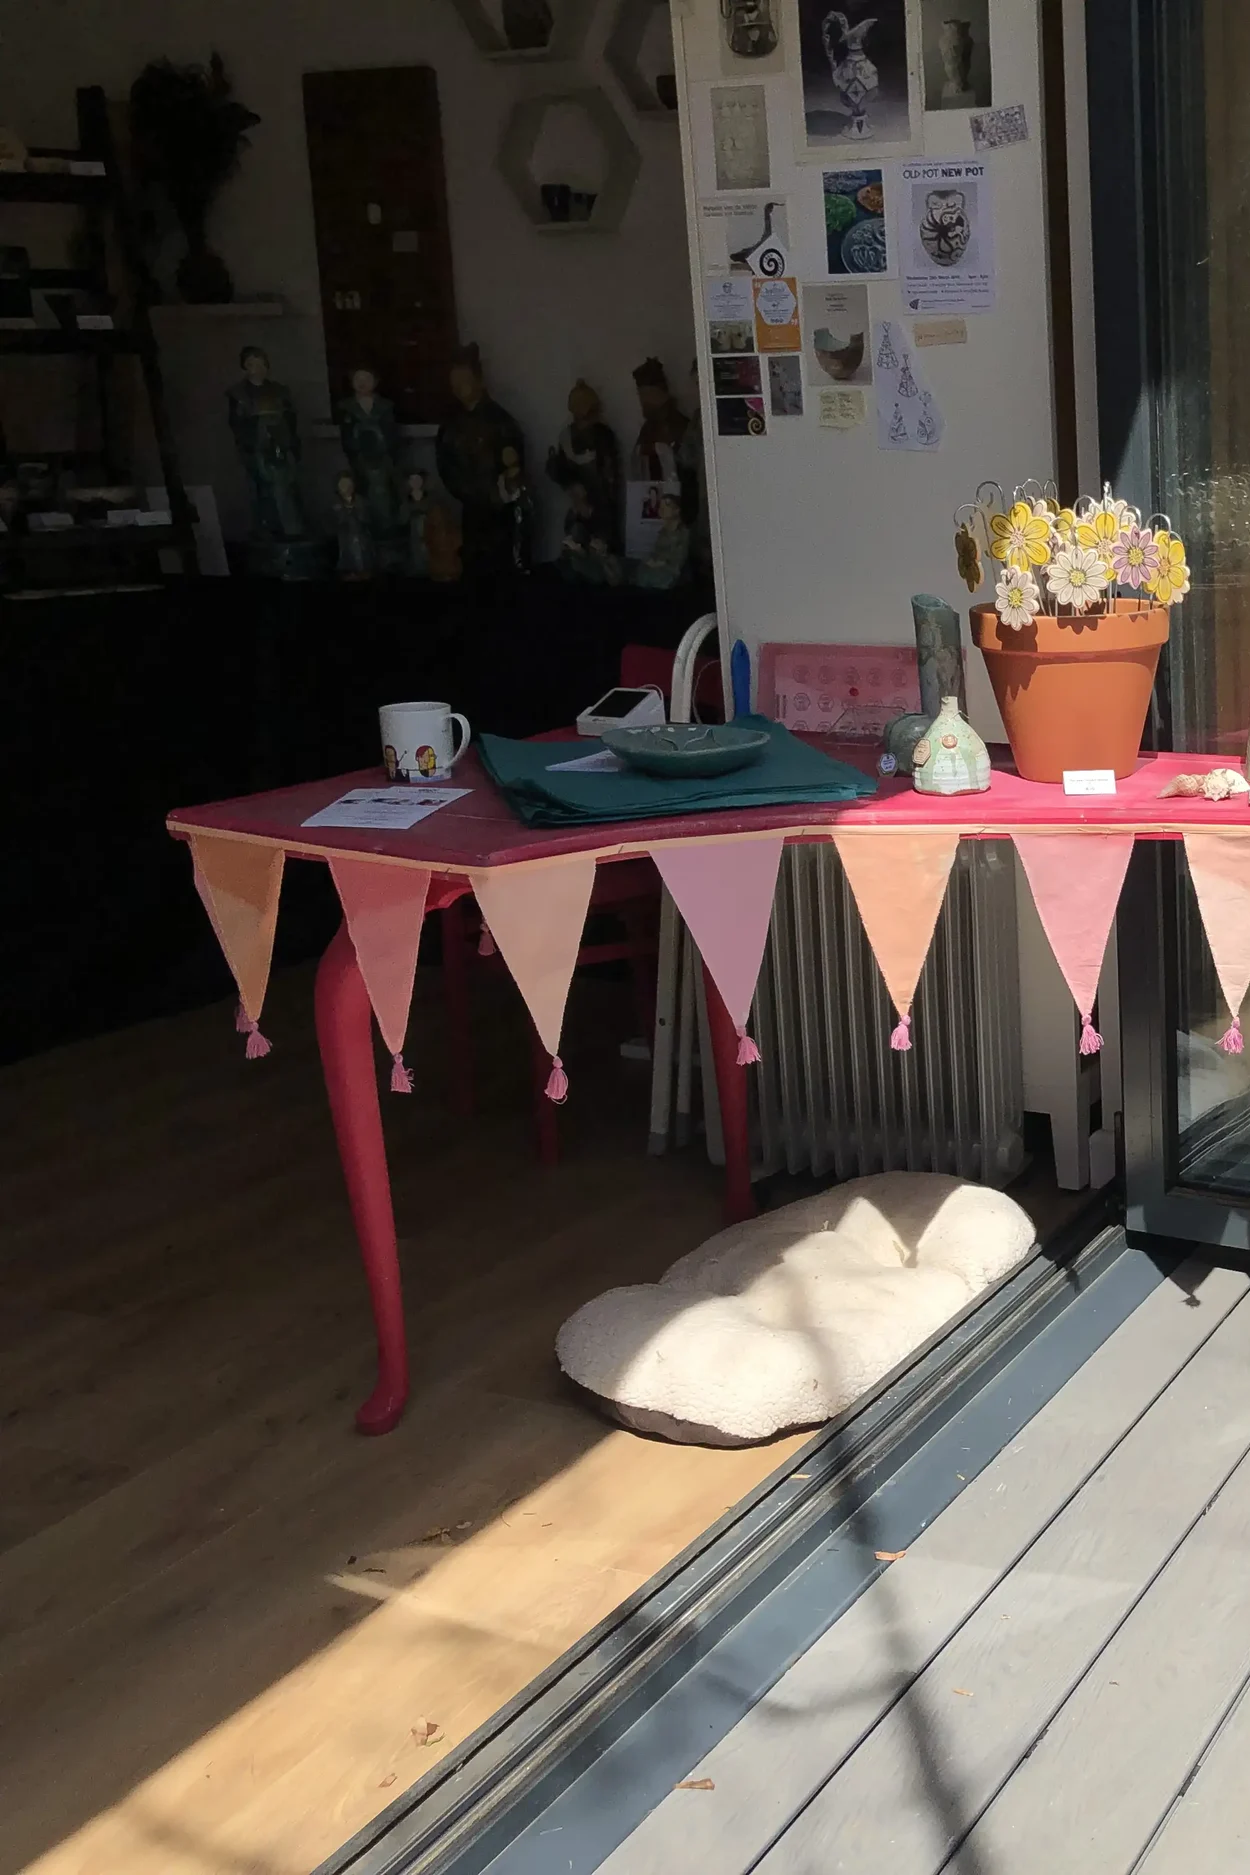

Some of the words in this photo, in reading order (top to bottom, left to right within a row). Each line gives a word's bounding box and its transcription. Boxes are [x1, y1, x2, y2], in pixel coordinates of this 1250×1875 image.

[902, 169, 920, 179] OLD
[922, 168, 938, 178] POT
[941, 167, 962, 177] NEW
[965, 166, 984, 176] POT
